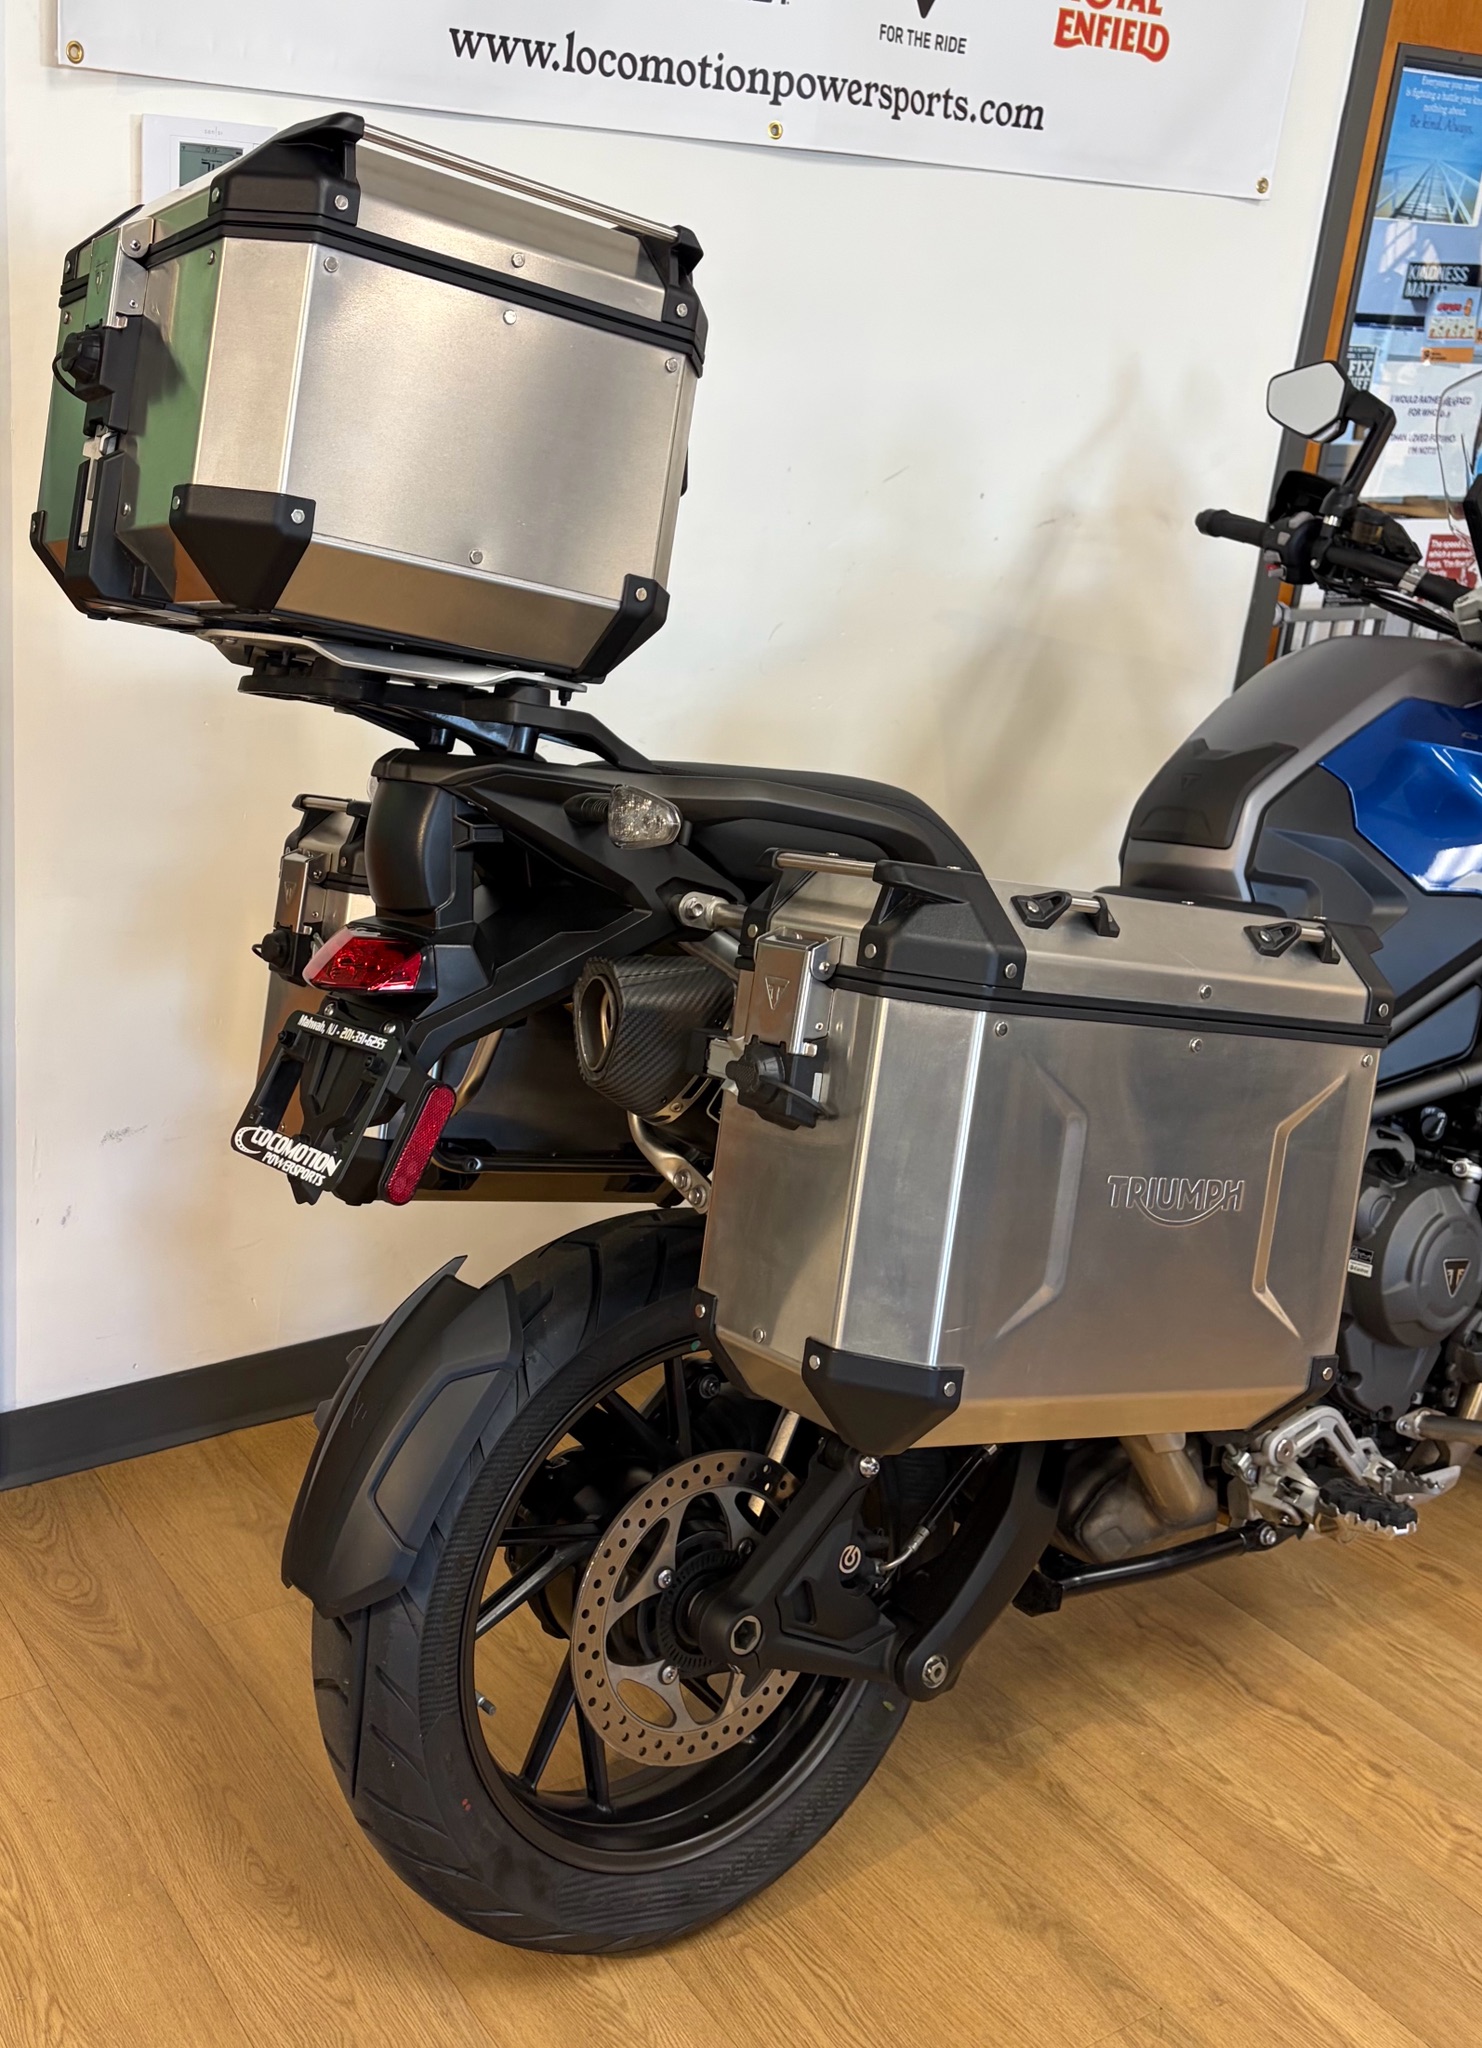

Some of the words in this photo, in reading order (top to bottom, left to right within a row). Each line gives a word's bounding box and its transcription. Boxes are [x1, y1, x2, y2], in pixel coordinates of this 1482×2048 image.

[879, 23, 904, 44] FOR
[907, 29, 932, 49] THE
[934, 34, 967, 54] RIDE
[1053, 7, 1170, 63] ENFIELD
[449, 27, 1045, 131] www.locomotionpowersports.com
[1408, 264, 1470, 283] KINDNESS
[1347, 360, 1373, 377] FIX
[297, 1014, 326, 1034] Mahwah,
[326, 1022, 338, 1036] NJ
[250, 1126, 343, 1177] LOCOMOTION
[262, 1151, 326, 1187] POWERSPORTS
[1107, 1174, 1246, 1227] TRIUMPH
